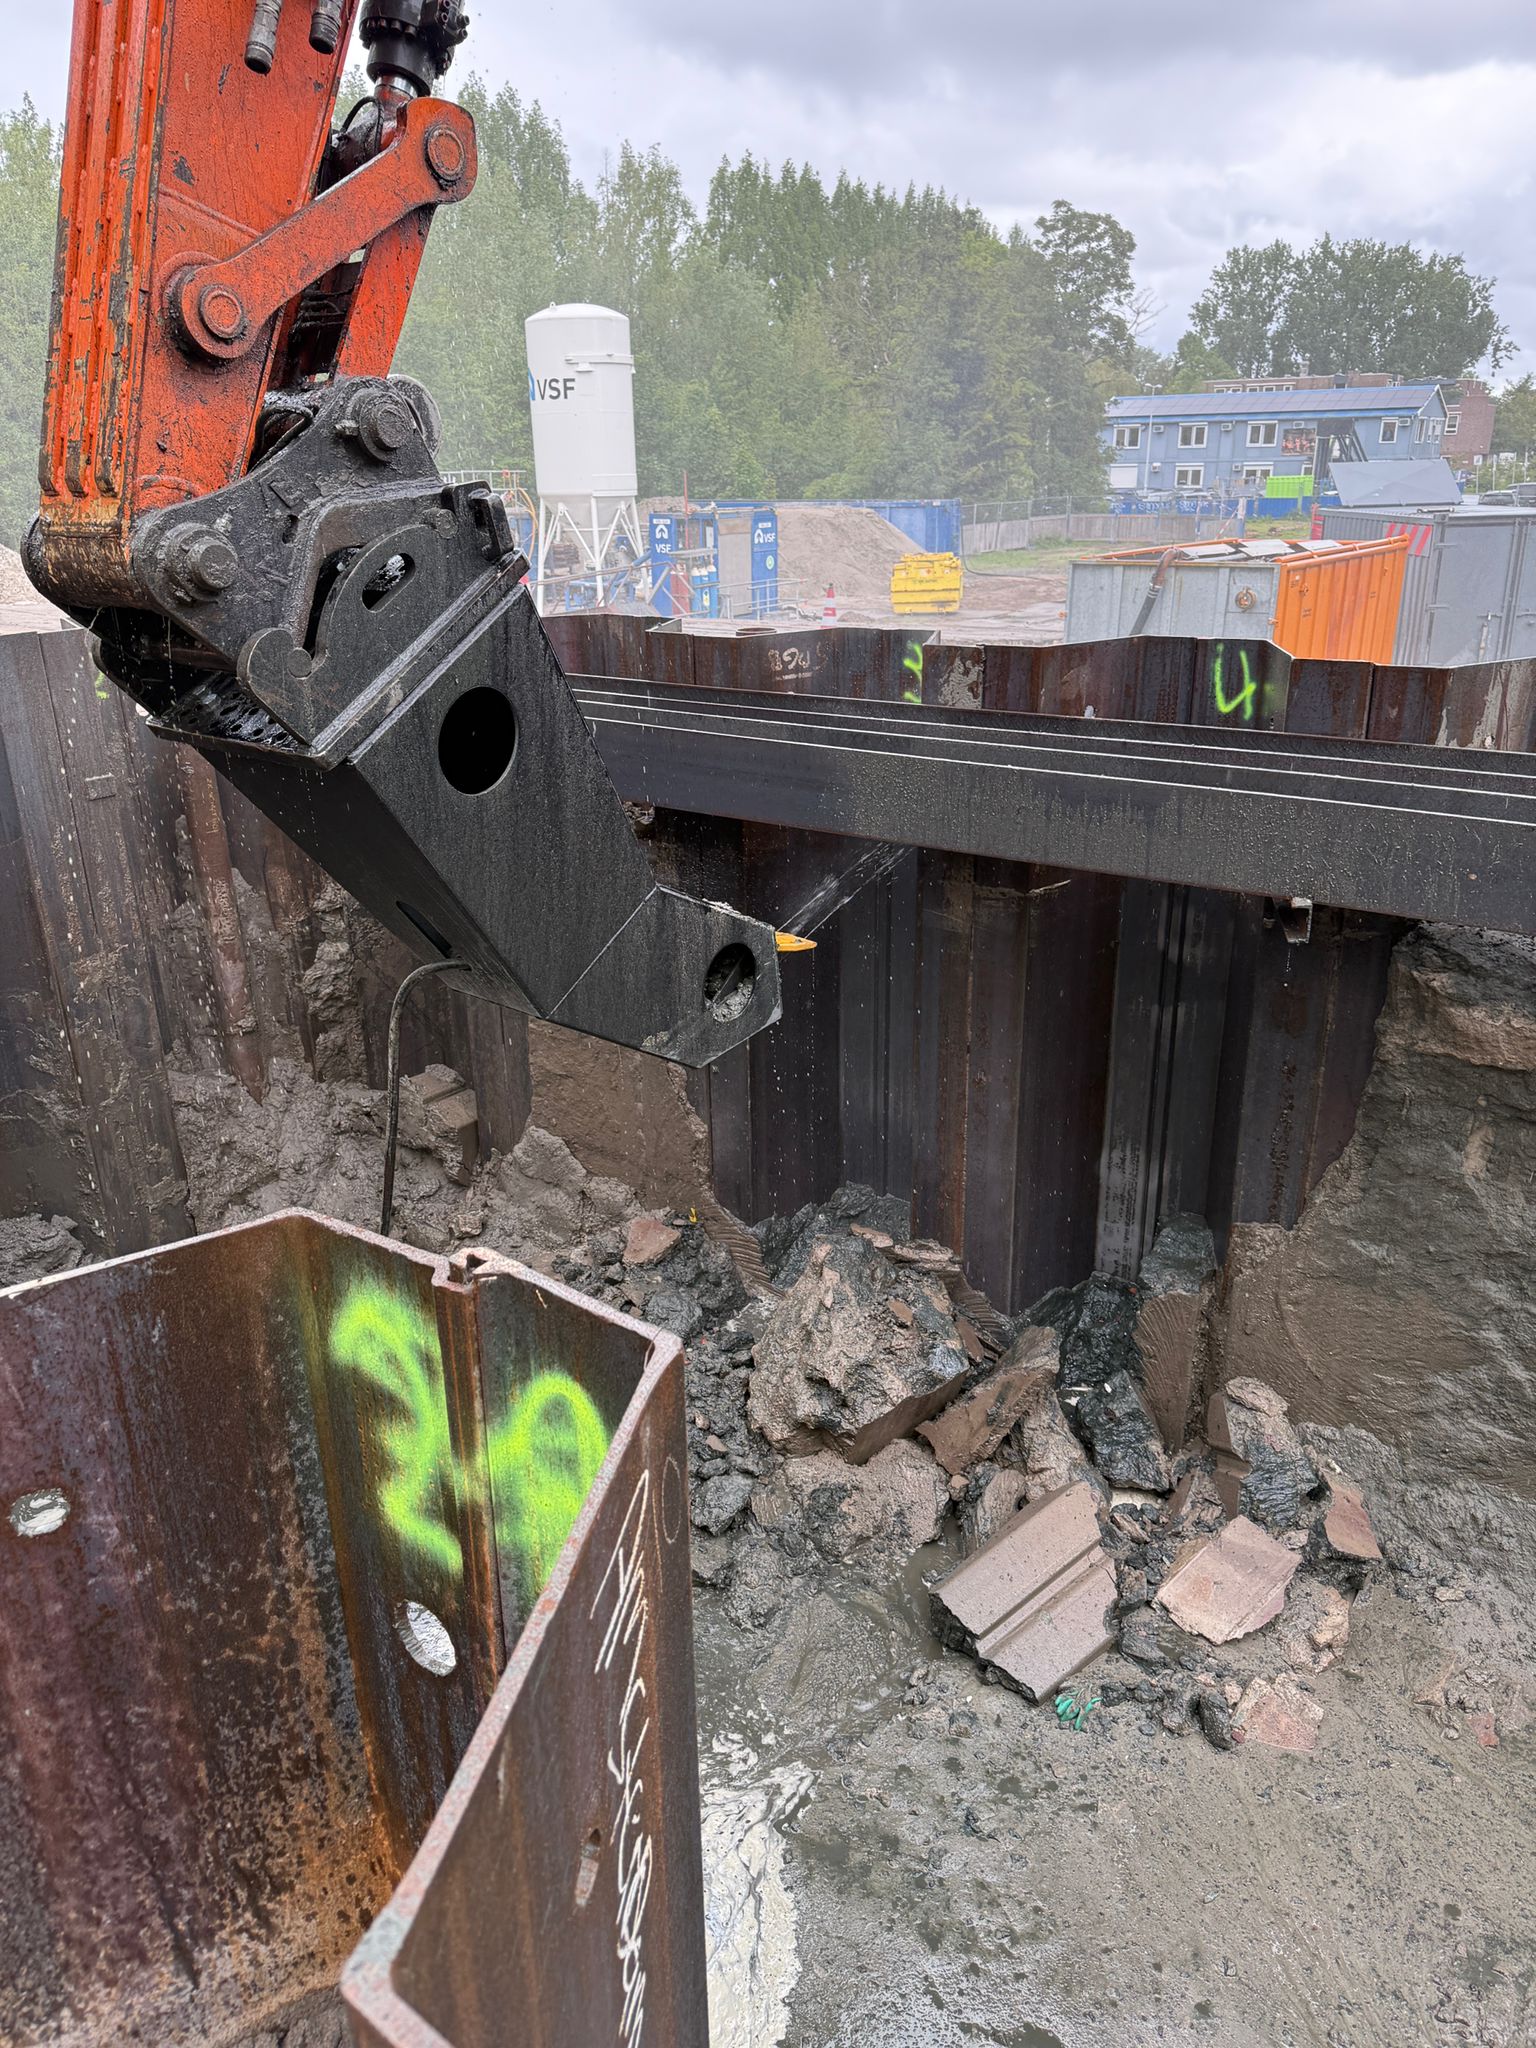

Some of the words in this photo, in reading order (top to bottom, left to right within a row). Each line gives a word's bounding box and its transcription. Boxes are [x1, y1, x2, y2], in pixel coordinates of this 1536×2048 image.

[536, 378, 576, 400] VSF
[655, 543, 672, 554] VSF
[1214, 643, 1257, 720] 4
